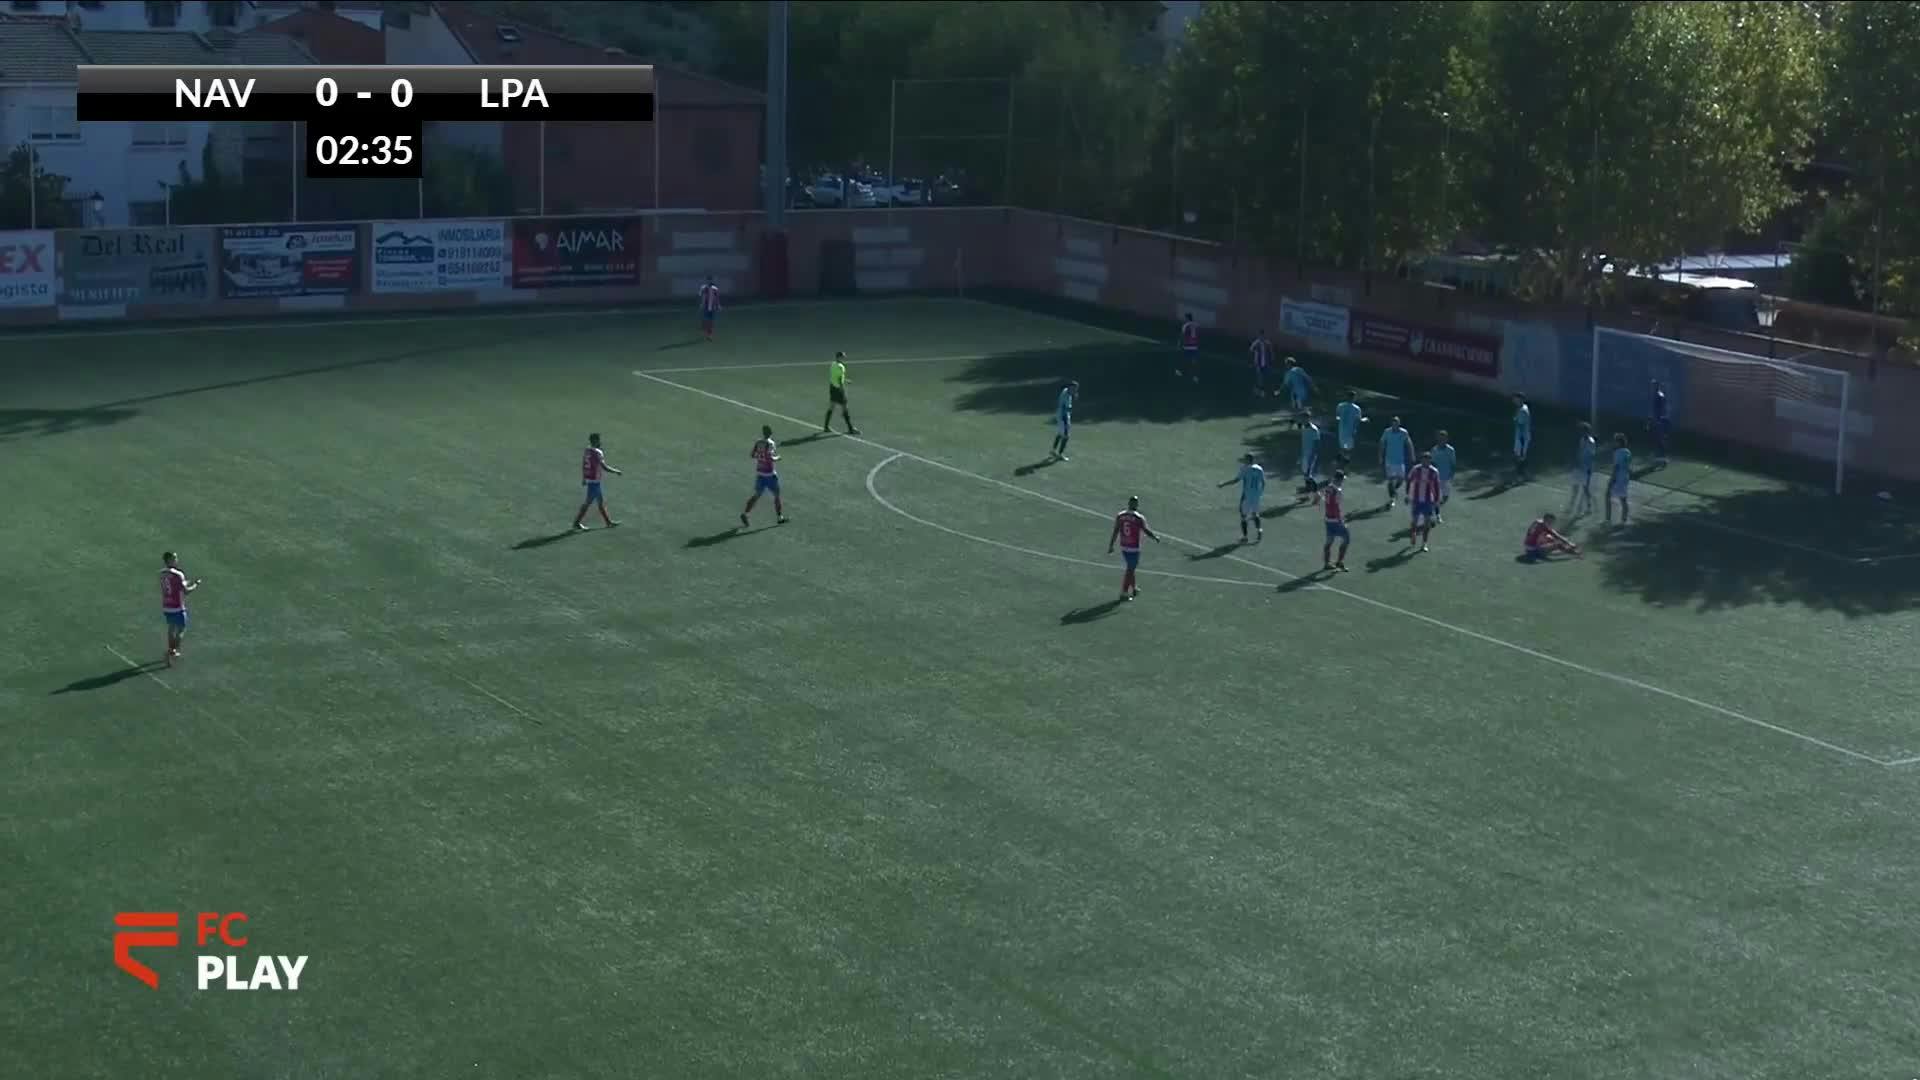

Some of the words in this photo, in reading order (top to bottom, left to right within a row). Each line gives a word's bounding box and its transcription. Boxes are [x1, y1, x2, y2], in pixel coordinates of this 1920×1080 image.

[80, 234, 121, 257] Del
[133, 232, 185, 255] Real
[556, 229, 625, 253] AIMAR
[0, 283, 49, 298] gista
